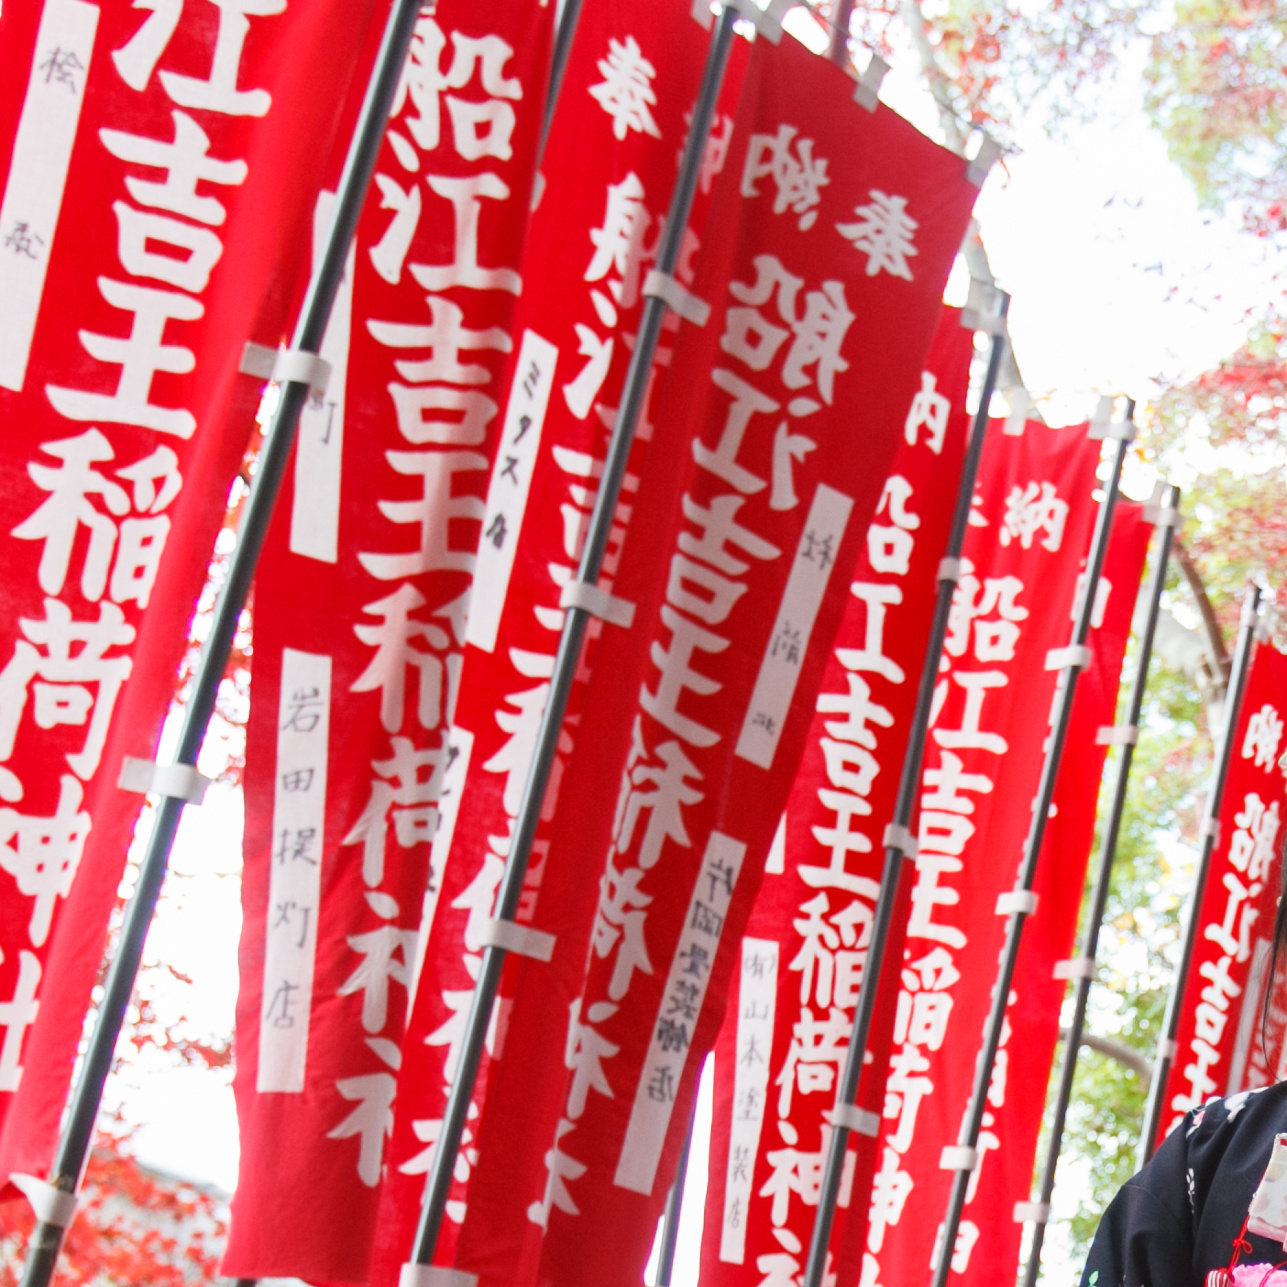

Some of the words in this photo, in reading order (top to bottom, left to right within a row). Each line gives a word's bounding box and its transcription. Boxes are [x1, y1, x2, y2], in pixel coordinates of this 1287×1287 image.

[266, 686, 323, 1030] 岩田提灯店
